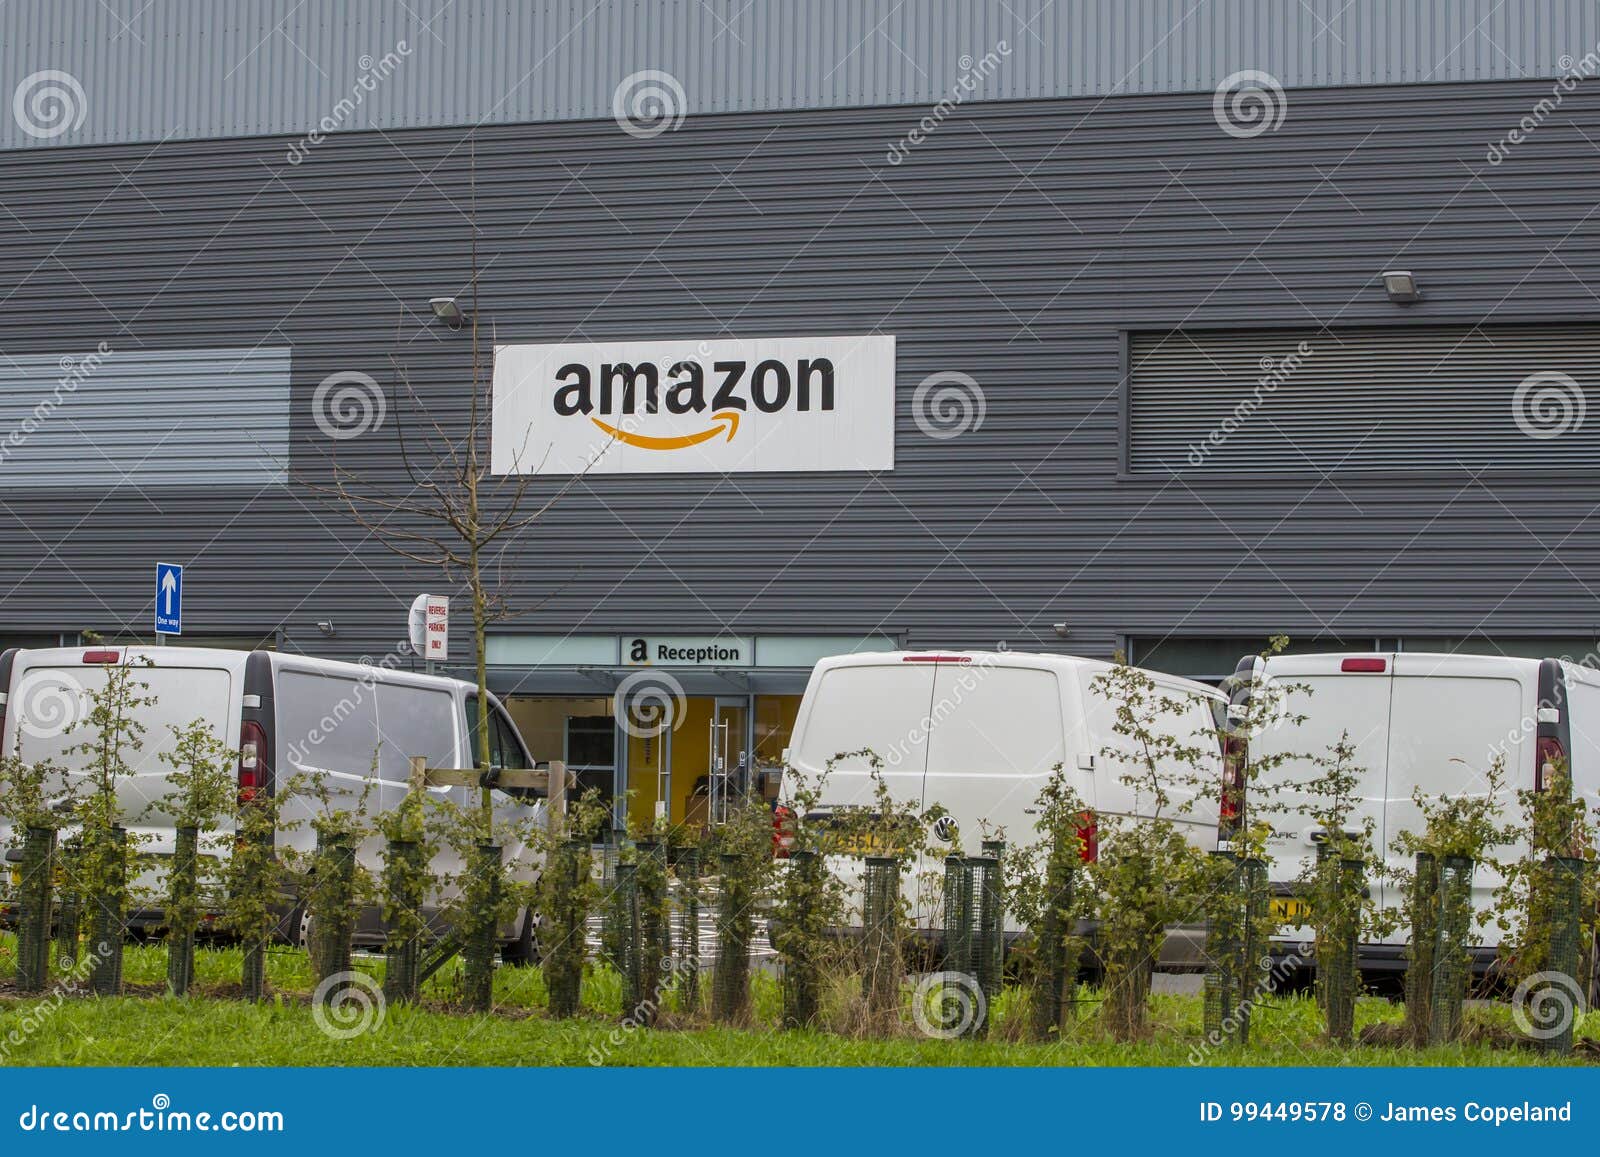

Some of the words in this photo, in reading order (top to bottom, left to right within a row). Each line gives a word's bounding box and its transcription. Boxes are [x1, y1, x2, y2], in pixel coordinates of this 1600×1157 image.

[553, 357, 835, 417] amazon
[428, 605, 446, 616] REVERSE
[157, 616, 168, 625] One
[168, 618, 179, 628] way
[428, 622, 446, 633] PARKING
[630, 638, 648, 662] a
[657, 644, 739, 663] Reception
